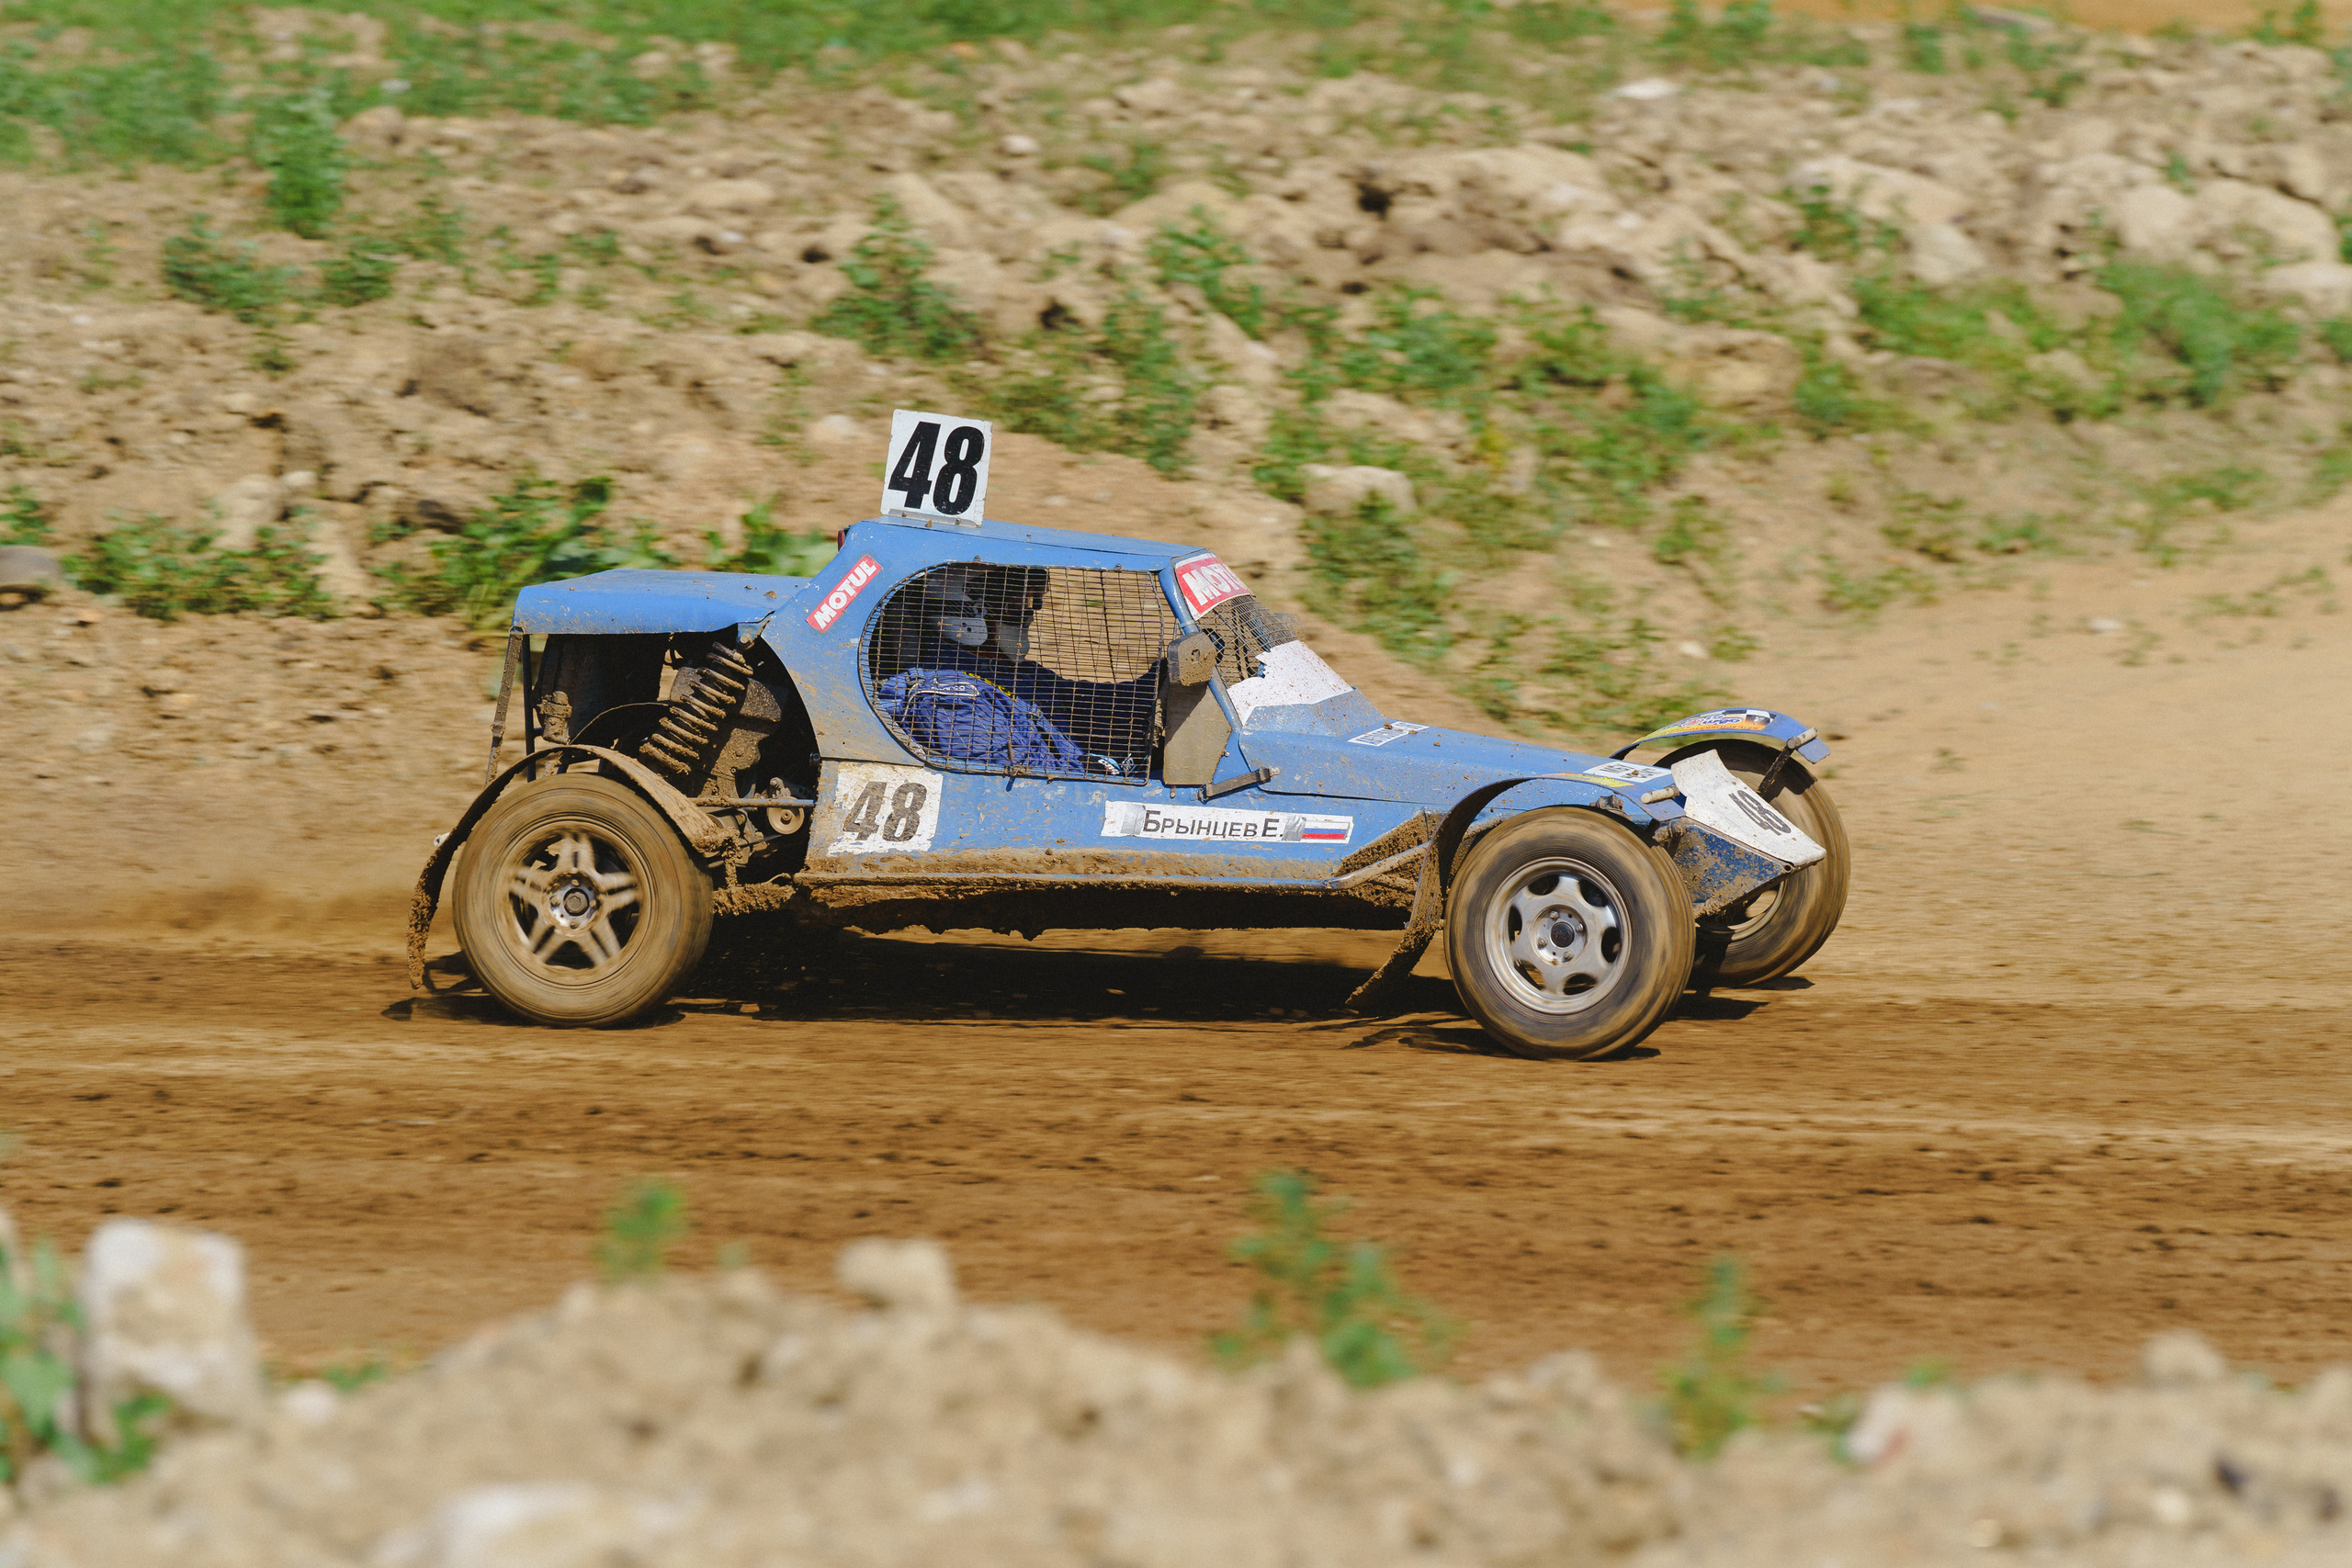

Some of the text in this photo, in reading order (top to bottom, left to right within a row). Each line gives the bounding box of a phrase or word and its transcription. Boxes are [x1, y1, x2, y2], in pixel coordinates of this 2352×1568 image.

[888, 421, 985, 515] 48
[813, 560, 876, 629] MOTUL
[1182, 563, 1250, 606] MOTU
[842, 781, 928, 842] 48
